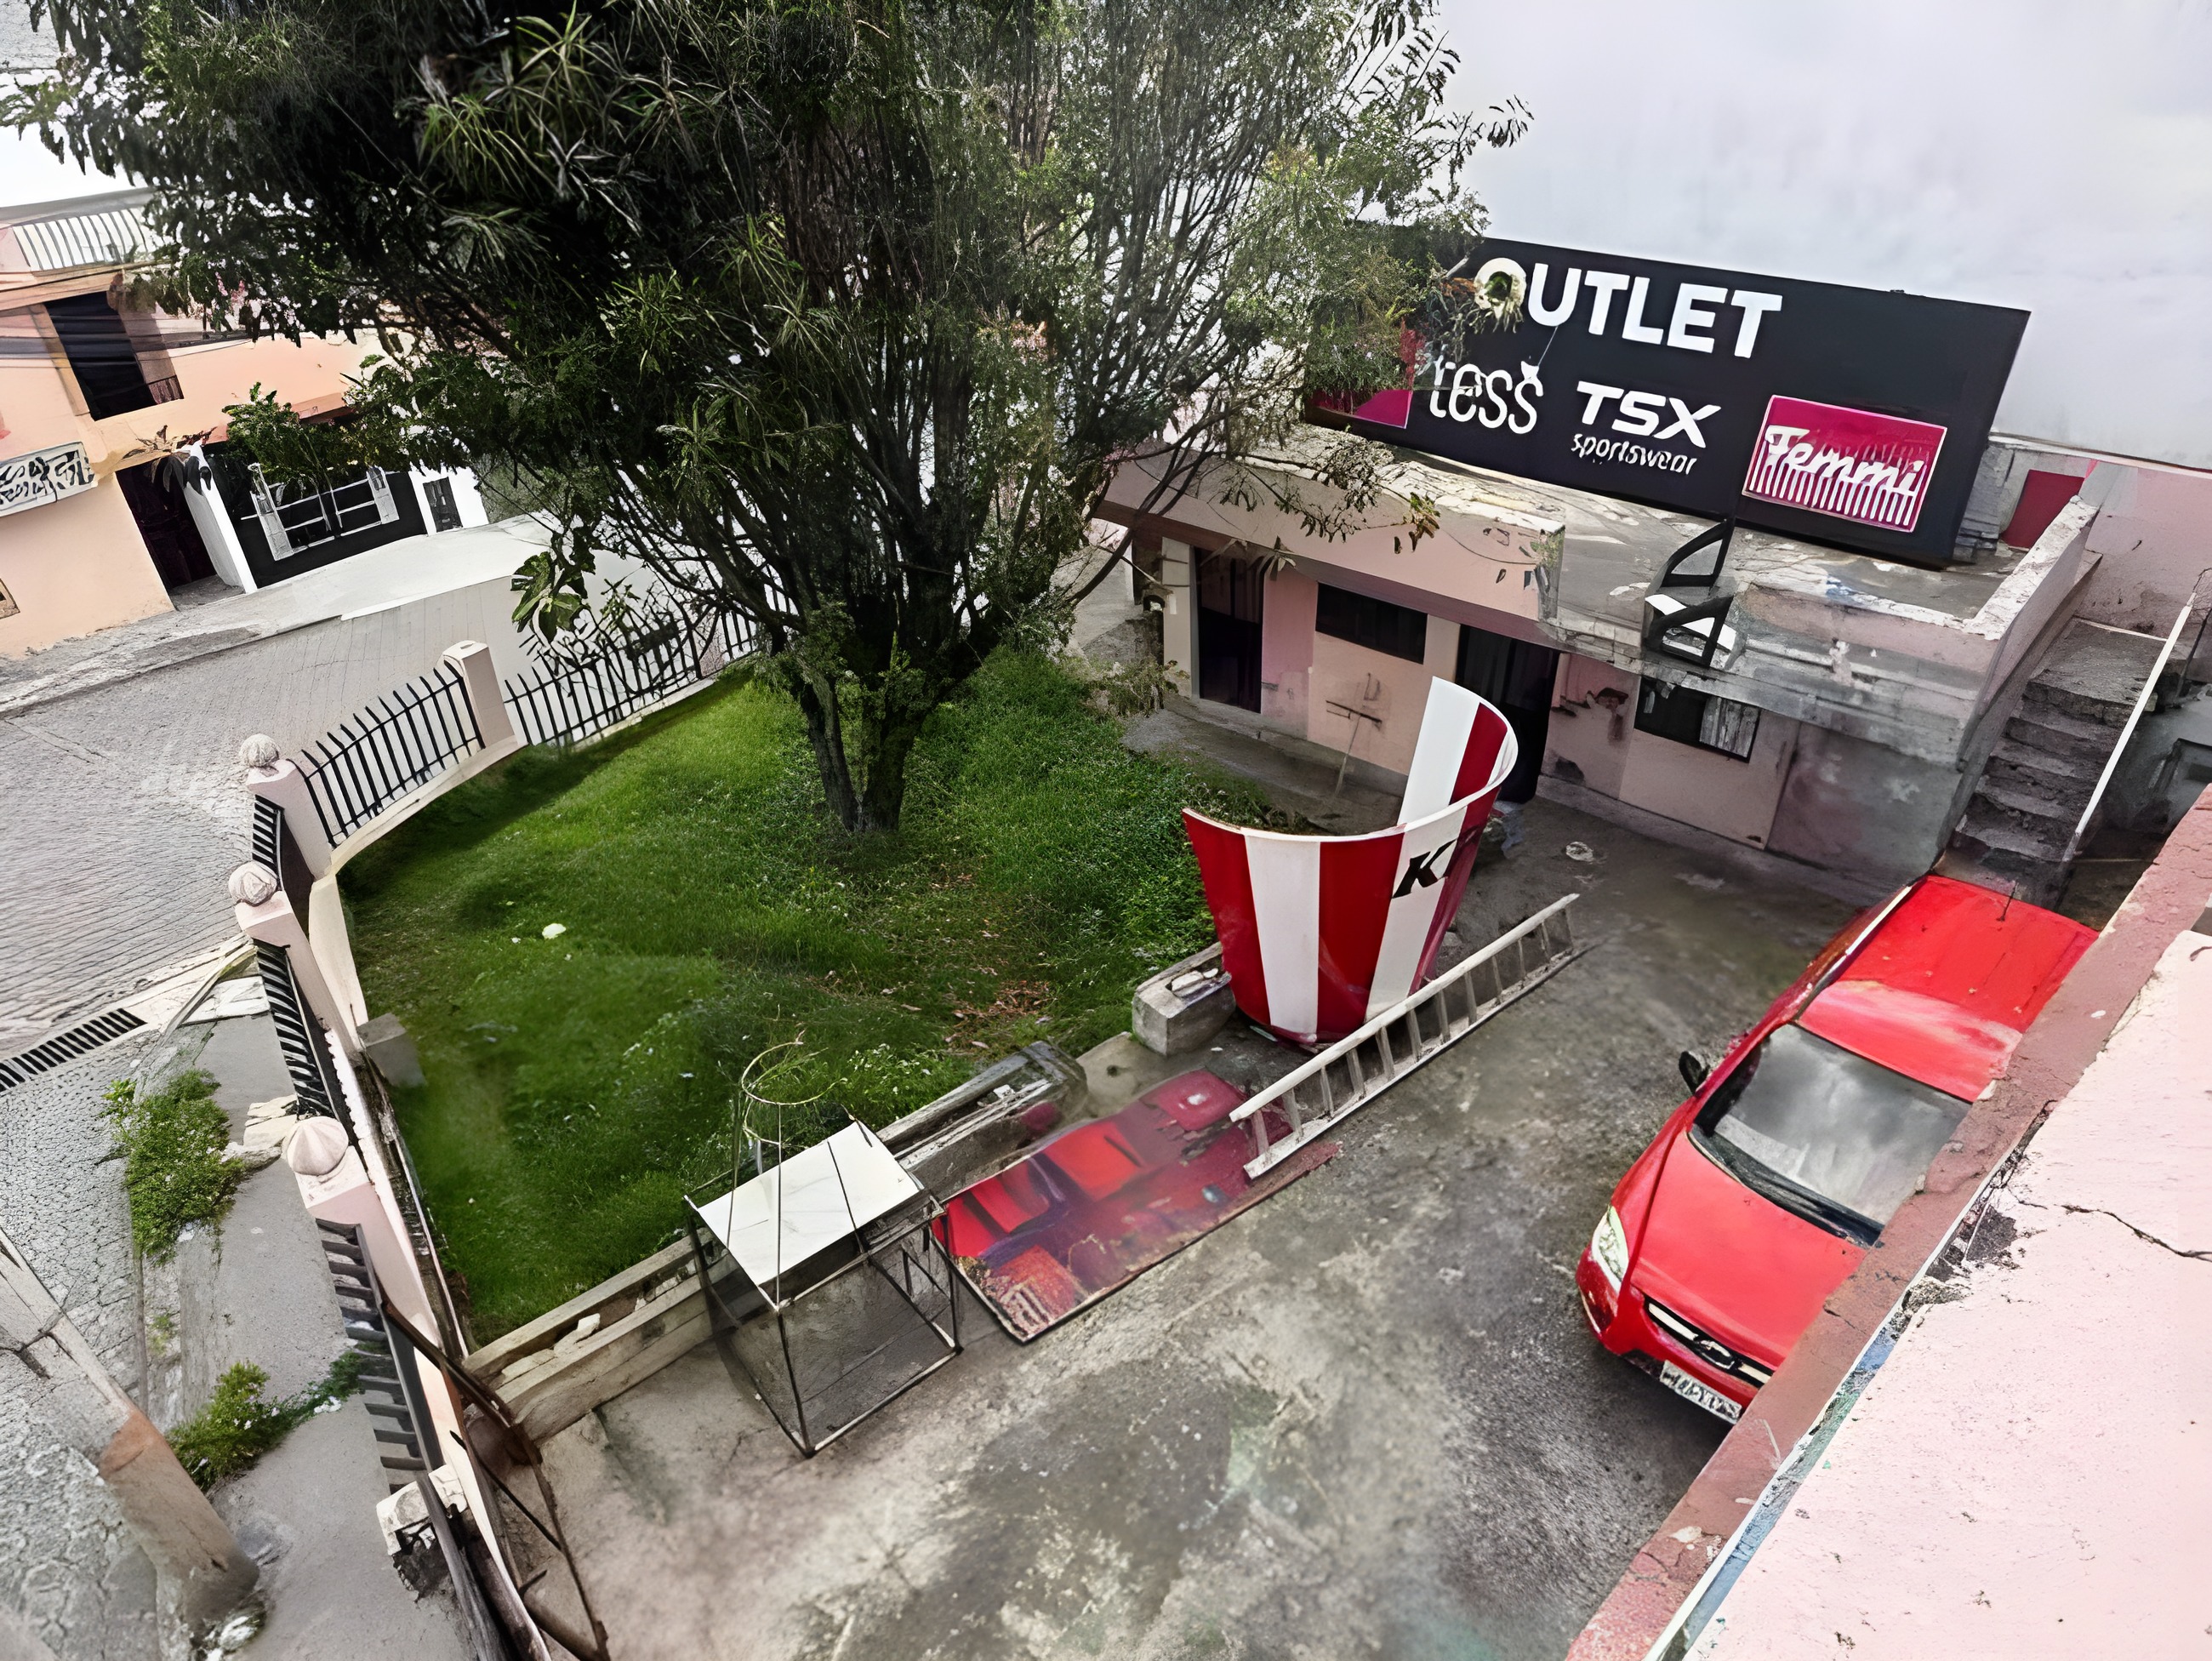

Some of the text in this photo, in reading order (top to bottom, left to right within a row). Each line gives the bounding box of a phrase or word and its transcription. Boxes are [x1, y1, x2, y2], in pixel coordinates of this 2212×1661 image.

[1474, 258, 1783, 358] OUTLET
[1576, 380, 1722, 448] TSX
[1571, 433, 1697, 475] sportswear
